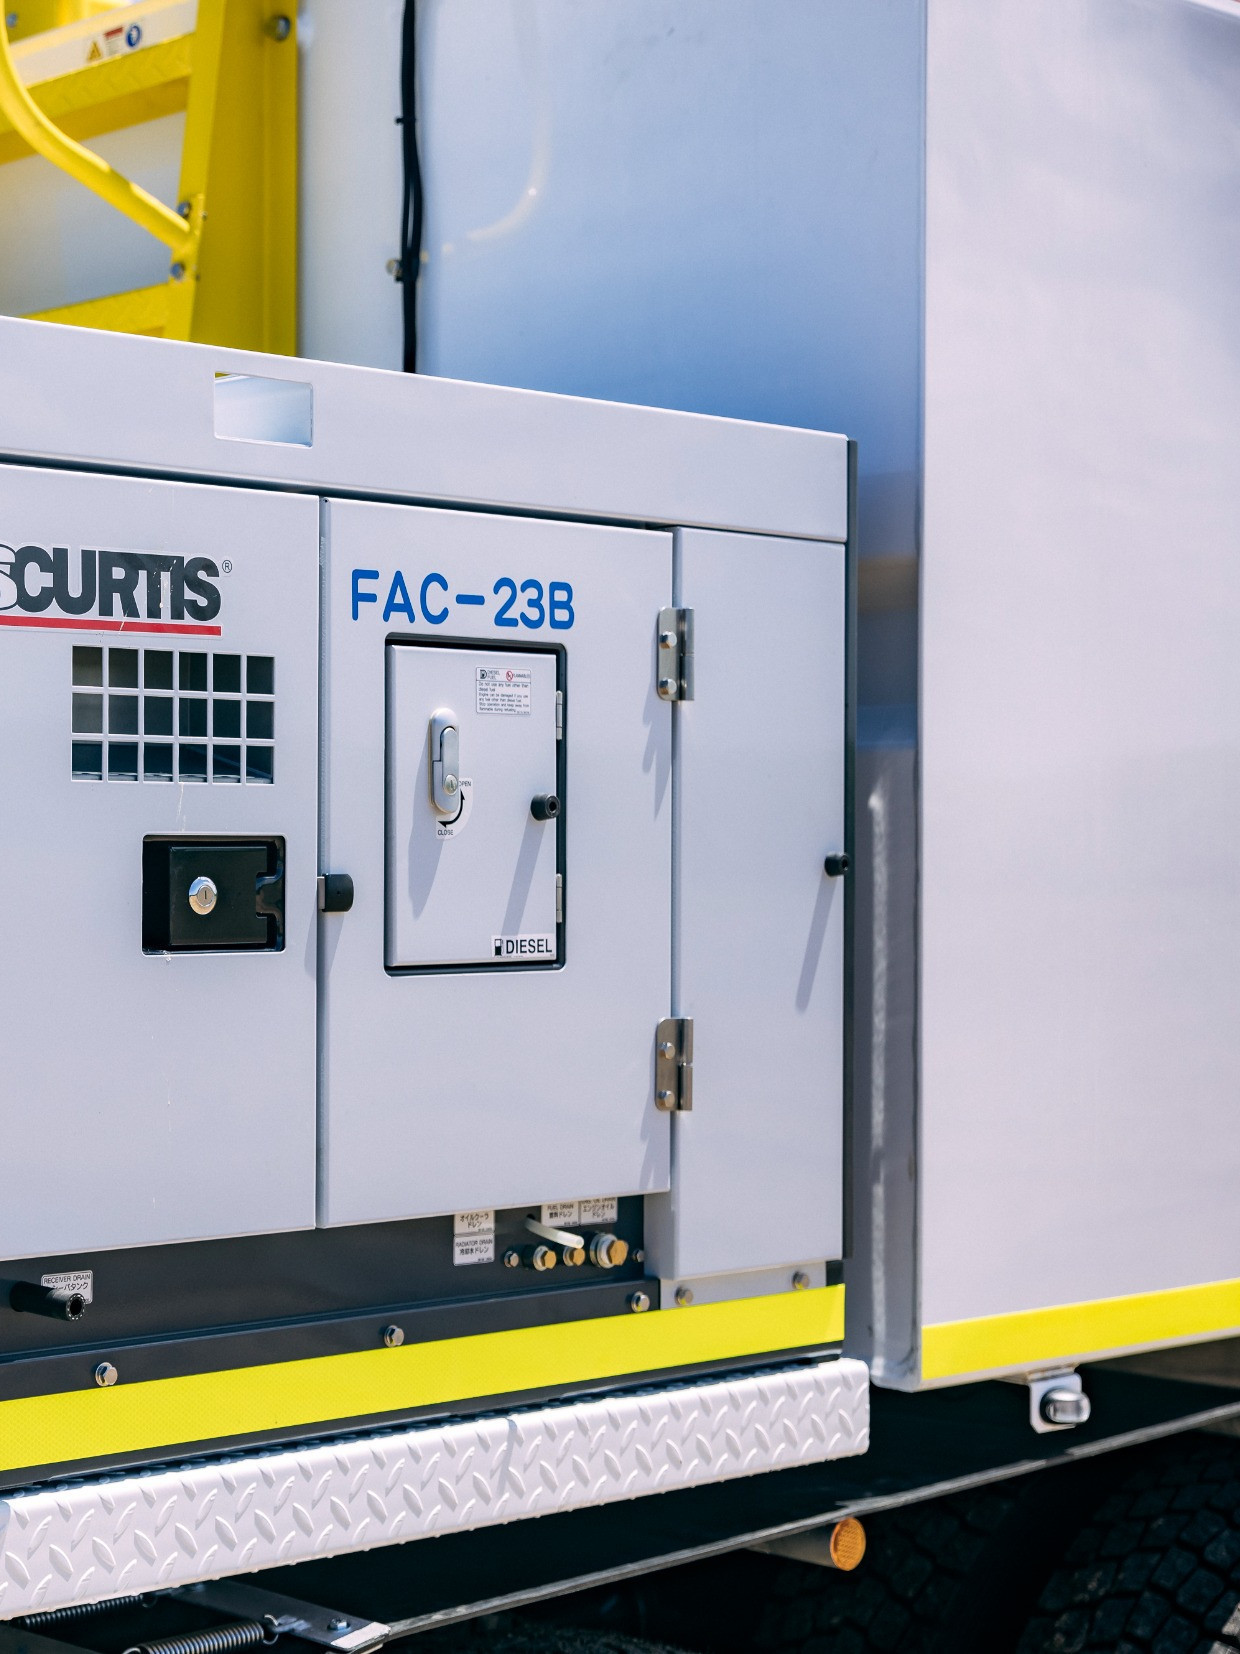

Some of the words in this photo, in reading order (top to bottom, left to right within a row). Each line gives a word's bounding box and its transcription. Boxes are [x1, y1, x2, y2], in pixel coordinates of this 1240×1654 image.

[352, 569, 575, 630] FAC-23B
[506, 939, 553, 954] DIESEL
[44, 1276, 71, 1284] RECEIVER
